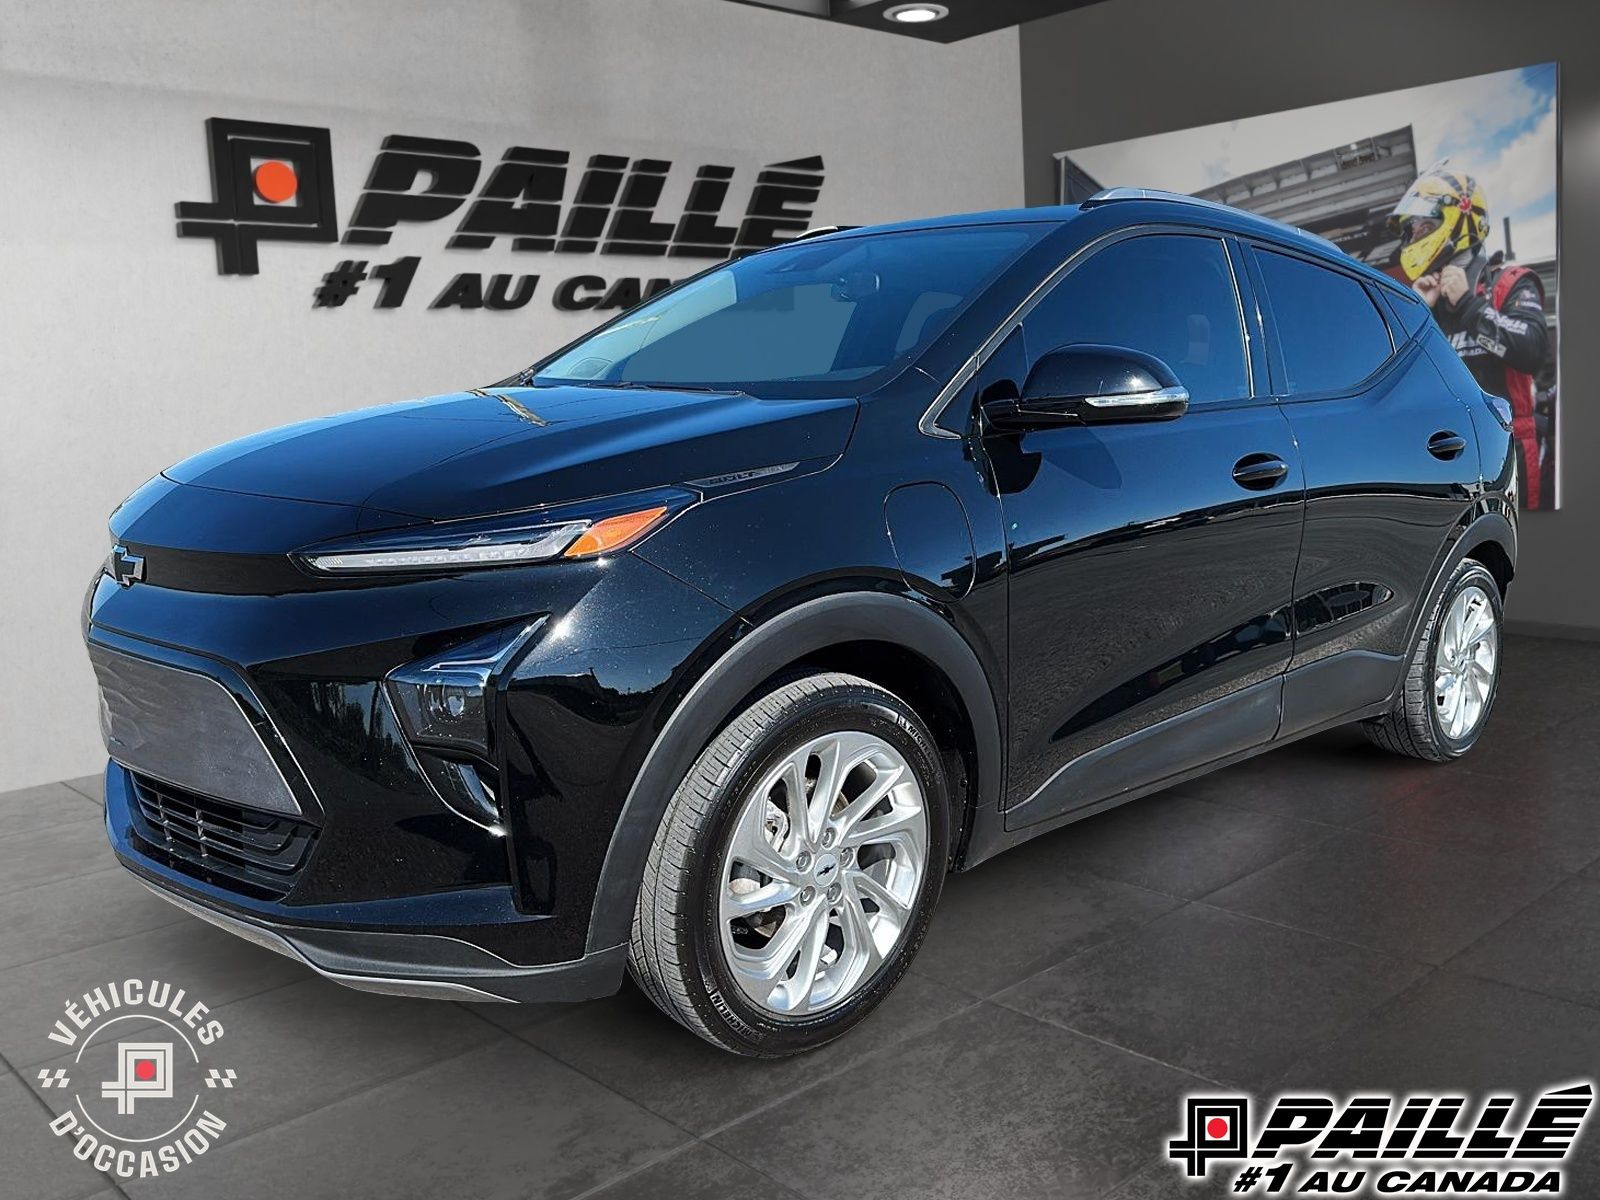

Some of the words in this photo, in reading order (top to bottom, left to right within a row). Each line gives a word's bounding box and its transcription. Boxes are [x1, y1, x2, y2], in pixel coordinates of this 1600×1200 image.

[341, 134, 825, 258] PAILLÉ
[312, 256, 421, 311] #1
[427, 273, 540, 311] AU
[710, 993, 754, 1037] MICHELIN
